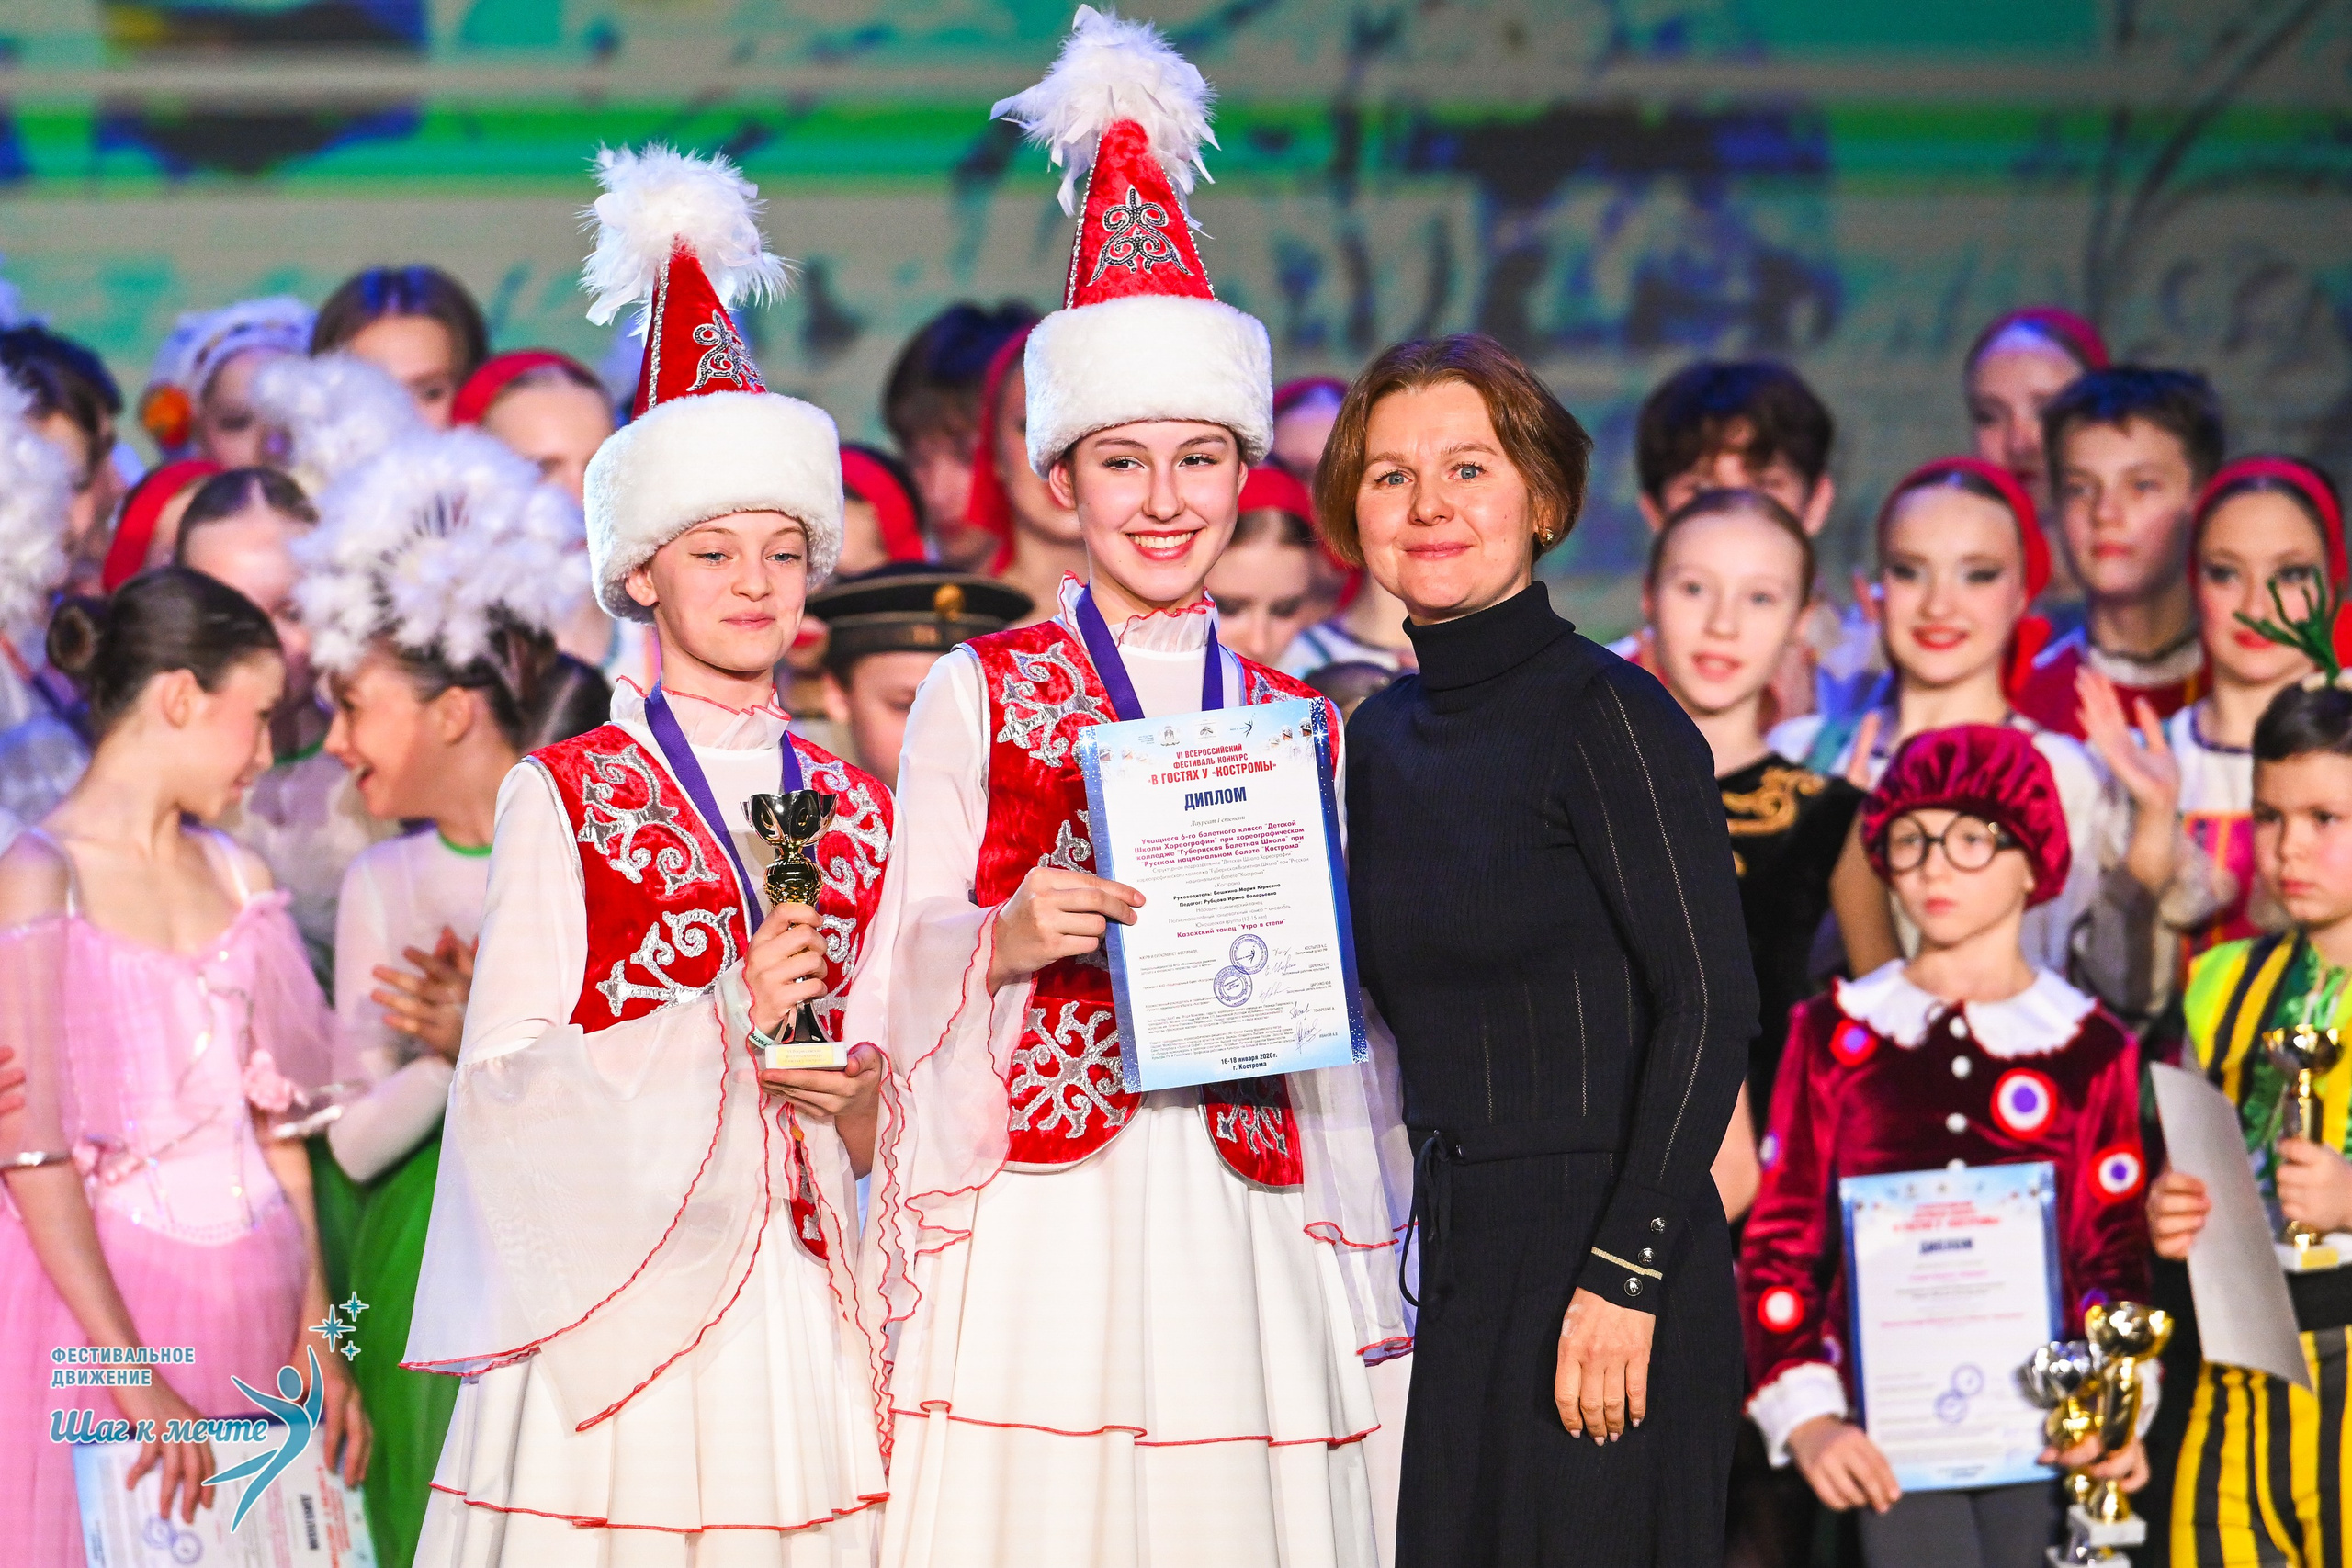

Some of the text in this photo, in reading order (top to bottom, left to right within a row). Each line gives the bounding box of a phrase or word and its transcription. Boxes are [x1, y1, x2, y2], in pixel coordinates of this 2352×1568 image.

[1184, 743, 1242, 758] ВСЕРОССИЙСКИЙ
[1172, 752, 1248, 769] ФЕСТИВАЛЬ-КОНКУРС
[1147, 760, 1276, 784] «В ГОСТЯХ У «КОСТРОМЫ»
[1184, 786, 1247, 811] ДИПЛОМ
[1140, 836, 1178, 844] Учащиеся
[1198, 829, 1236, 838] балетного
[1236, 828, 1304, 840] хореографическом
[1136, 852, 1174, 860] колледже
[1224, 840, 1259, 849] Балетная
[1177, 852, 1232, 863] национальном
[1172, 892, 1211, 900] Руководитель:
[1176, 928, 1214, 937] Казахский
[1238, 1061, 1266, 1069] Кострома
